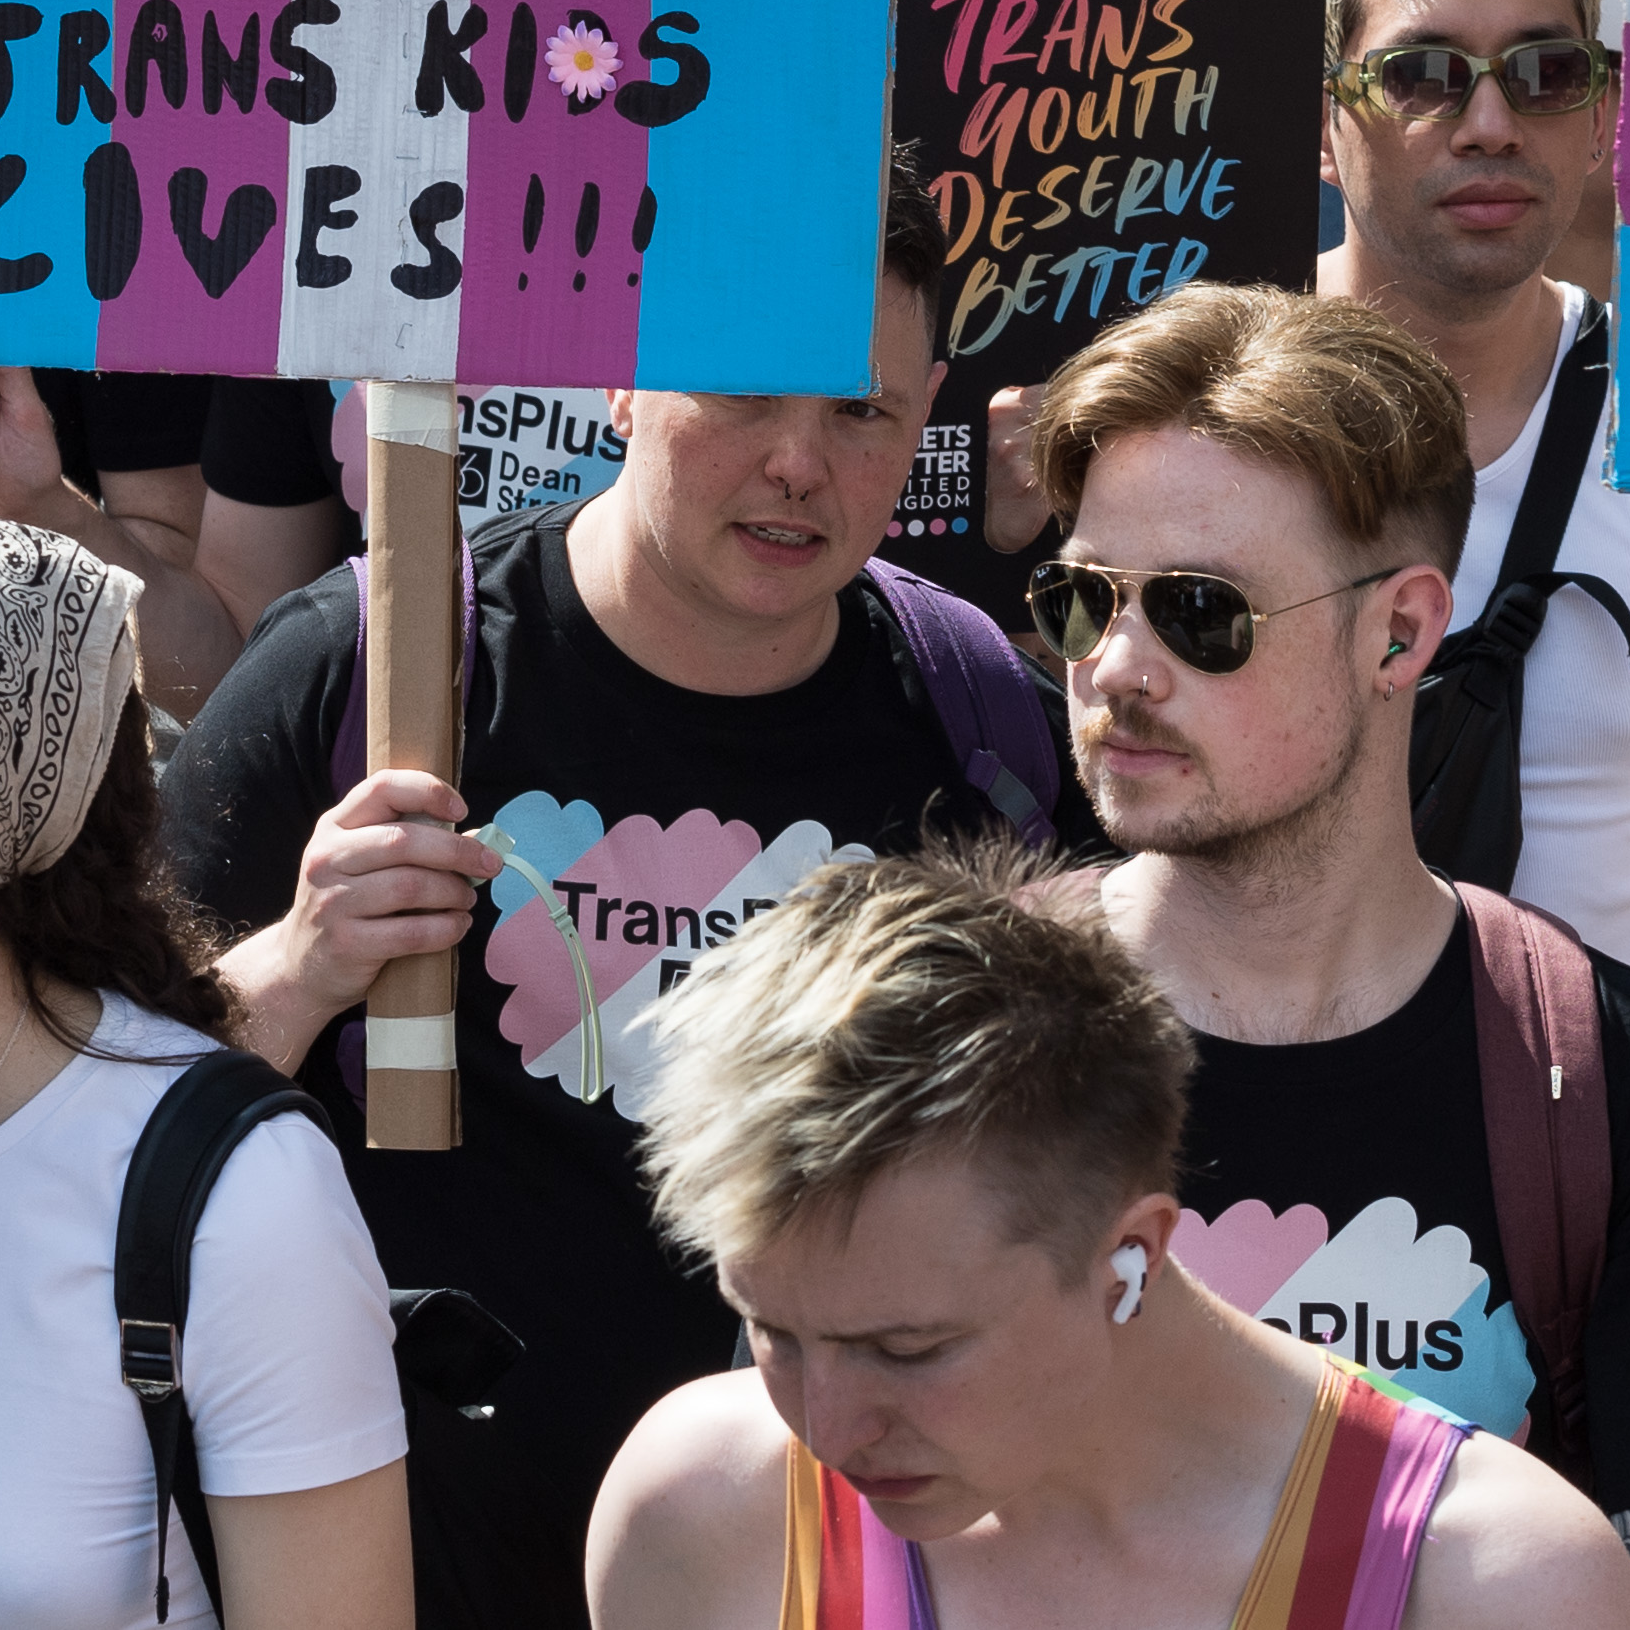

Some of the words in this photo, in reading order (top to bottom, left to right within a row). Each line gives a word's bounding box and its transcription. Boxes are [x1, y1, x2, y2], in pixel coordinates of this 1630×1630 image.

[960, 65, 1220, 188] YOUTH
[927, 146, 1242, 266] DESERVE
[918, 424, 971, 450] ETS
[498, 450, 582, 496] Dean
[909, 450, 971, 475] TER
